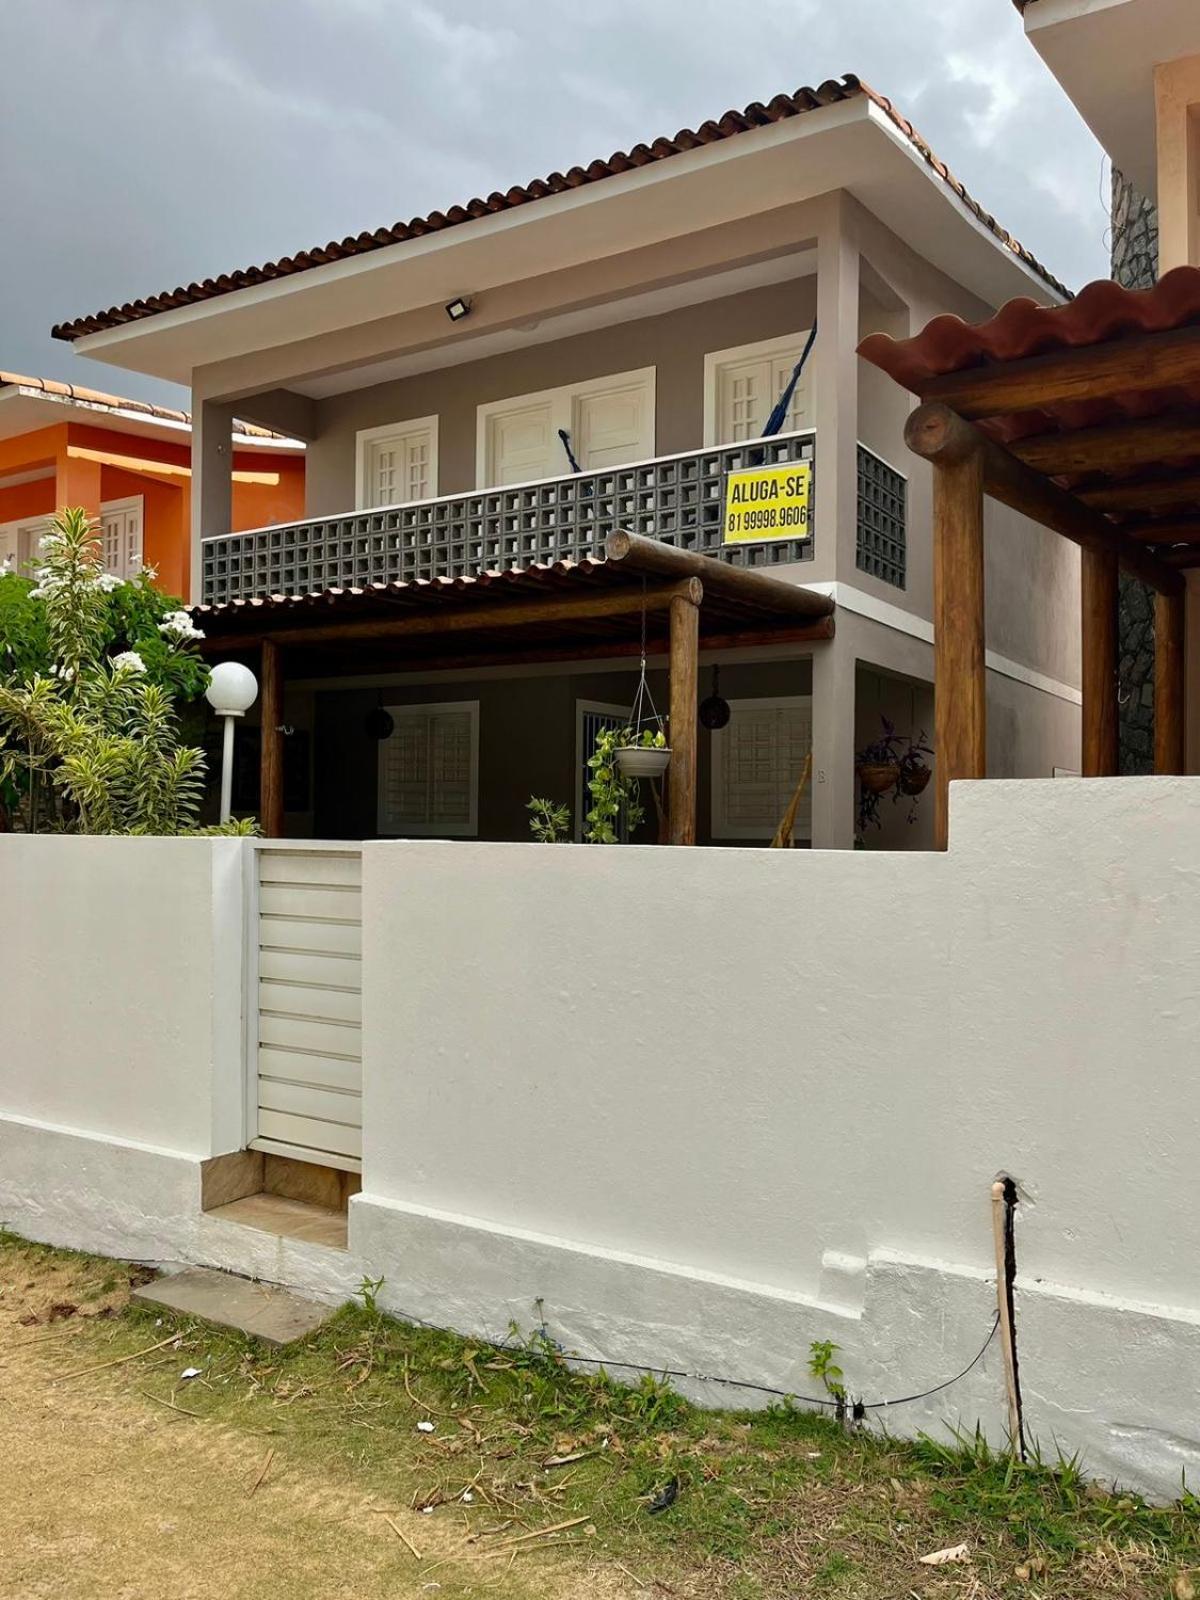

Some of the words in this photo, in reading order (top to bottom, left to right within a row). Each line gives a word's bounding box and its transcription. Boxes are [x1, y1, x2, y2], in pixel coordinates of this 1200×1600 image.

[732, 475, 805, 504] ALUGA-SE
[728, 513, 741, 531] 81
[743, 505, 806, 531] 99998.9606
